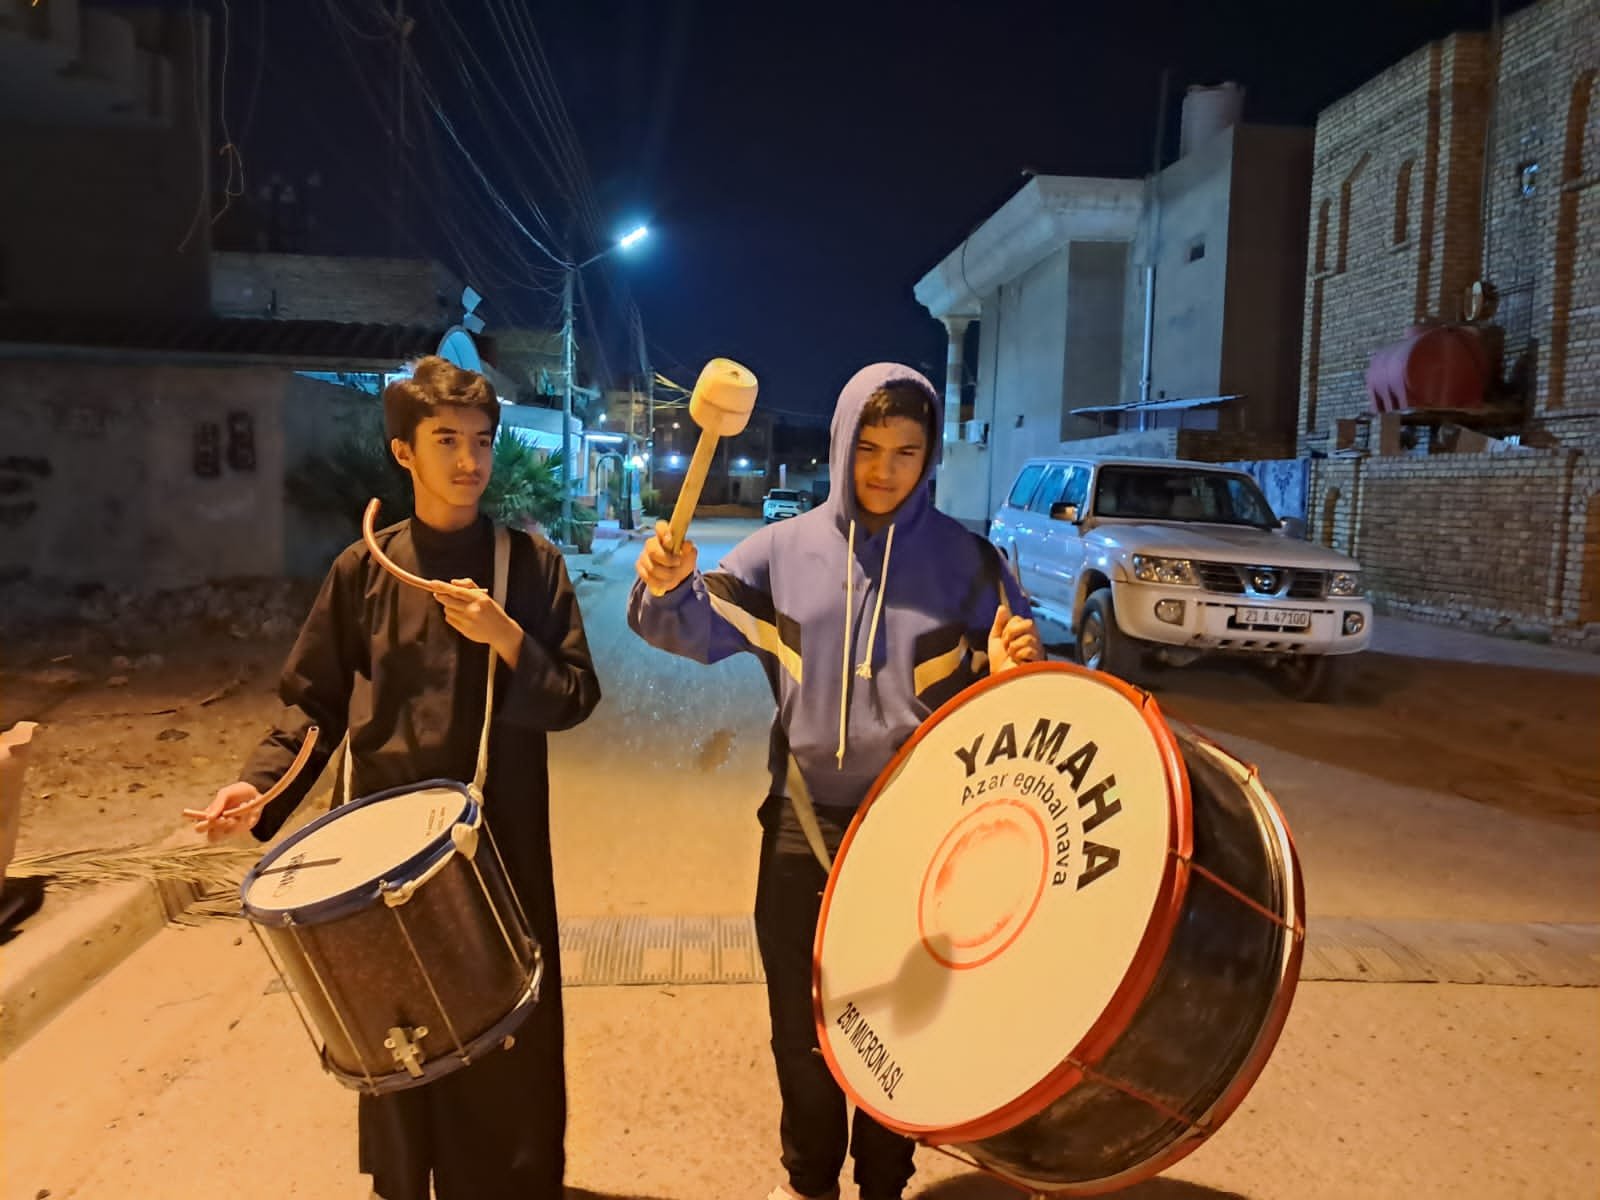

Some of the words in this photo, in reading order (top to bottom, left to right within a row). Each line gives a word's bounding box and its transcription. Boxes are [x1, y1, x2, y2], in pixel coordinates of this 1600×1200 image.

[955, 718, 1122, 891] YAMAHA
[1013, 772, 1068, 821] eghbal
[1052, 822, 1070, 886] nava
[836, 1001, 860, 1035] 250
[849, 1018, 890, 1078] MICRON
[877, 1061, 904, 1100] ASL
